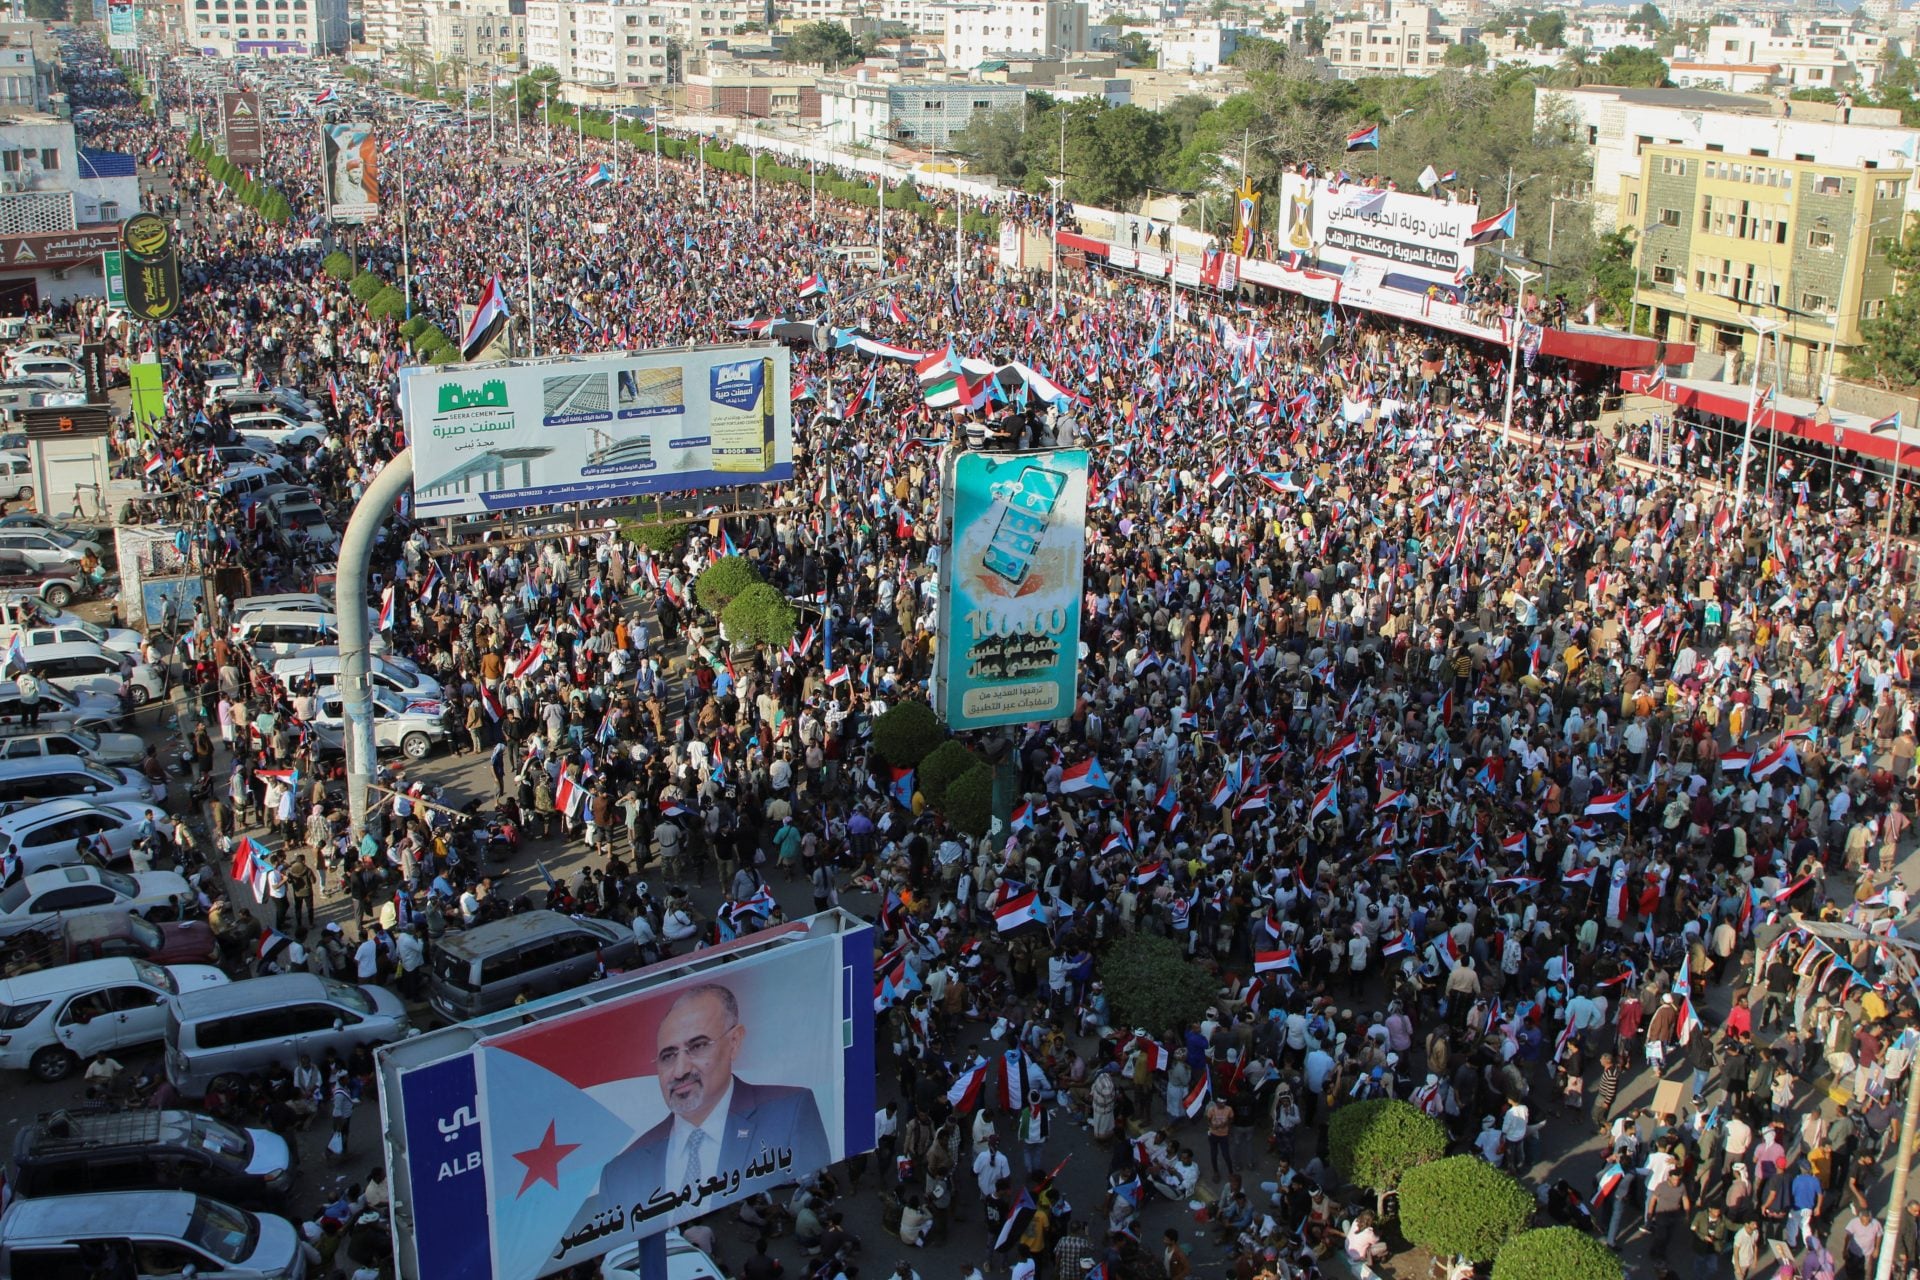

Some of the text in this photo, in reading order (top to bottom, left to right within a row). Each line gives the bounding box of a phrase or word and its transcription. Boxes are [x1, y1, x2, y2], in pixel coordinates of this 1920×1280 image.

[1328, 206, 1460, 246] إعلان دولة الجنوب العربي
[43, 237, 88, 253] الإسلامي
[1326, 230, 1458, 269] لحماية العروبة ومكافحة الإرهاب
[433, 415, 515, 439] أسمنت صيرة
[966, 637, 1061, 660] مشترك في تطبيق
[966, 654, 1060, 679] العمقي جوال
[979, 685, 1043, 701] ترقبوا العديد من
[969, 704, 1000, 715] التطبيق
[1001, 703, 1016, 711] عبر
[553, 1140, 793, 1261] بالله وبعزمكم ننتصر
